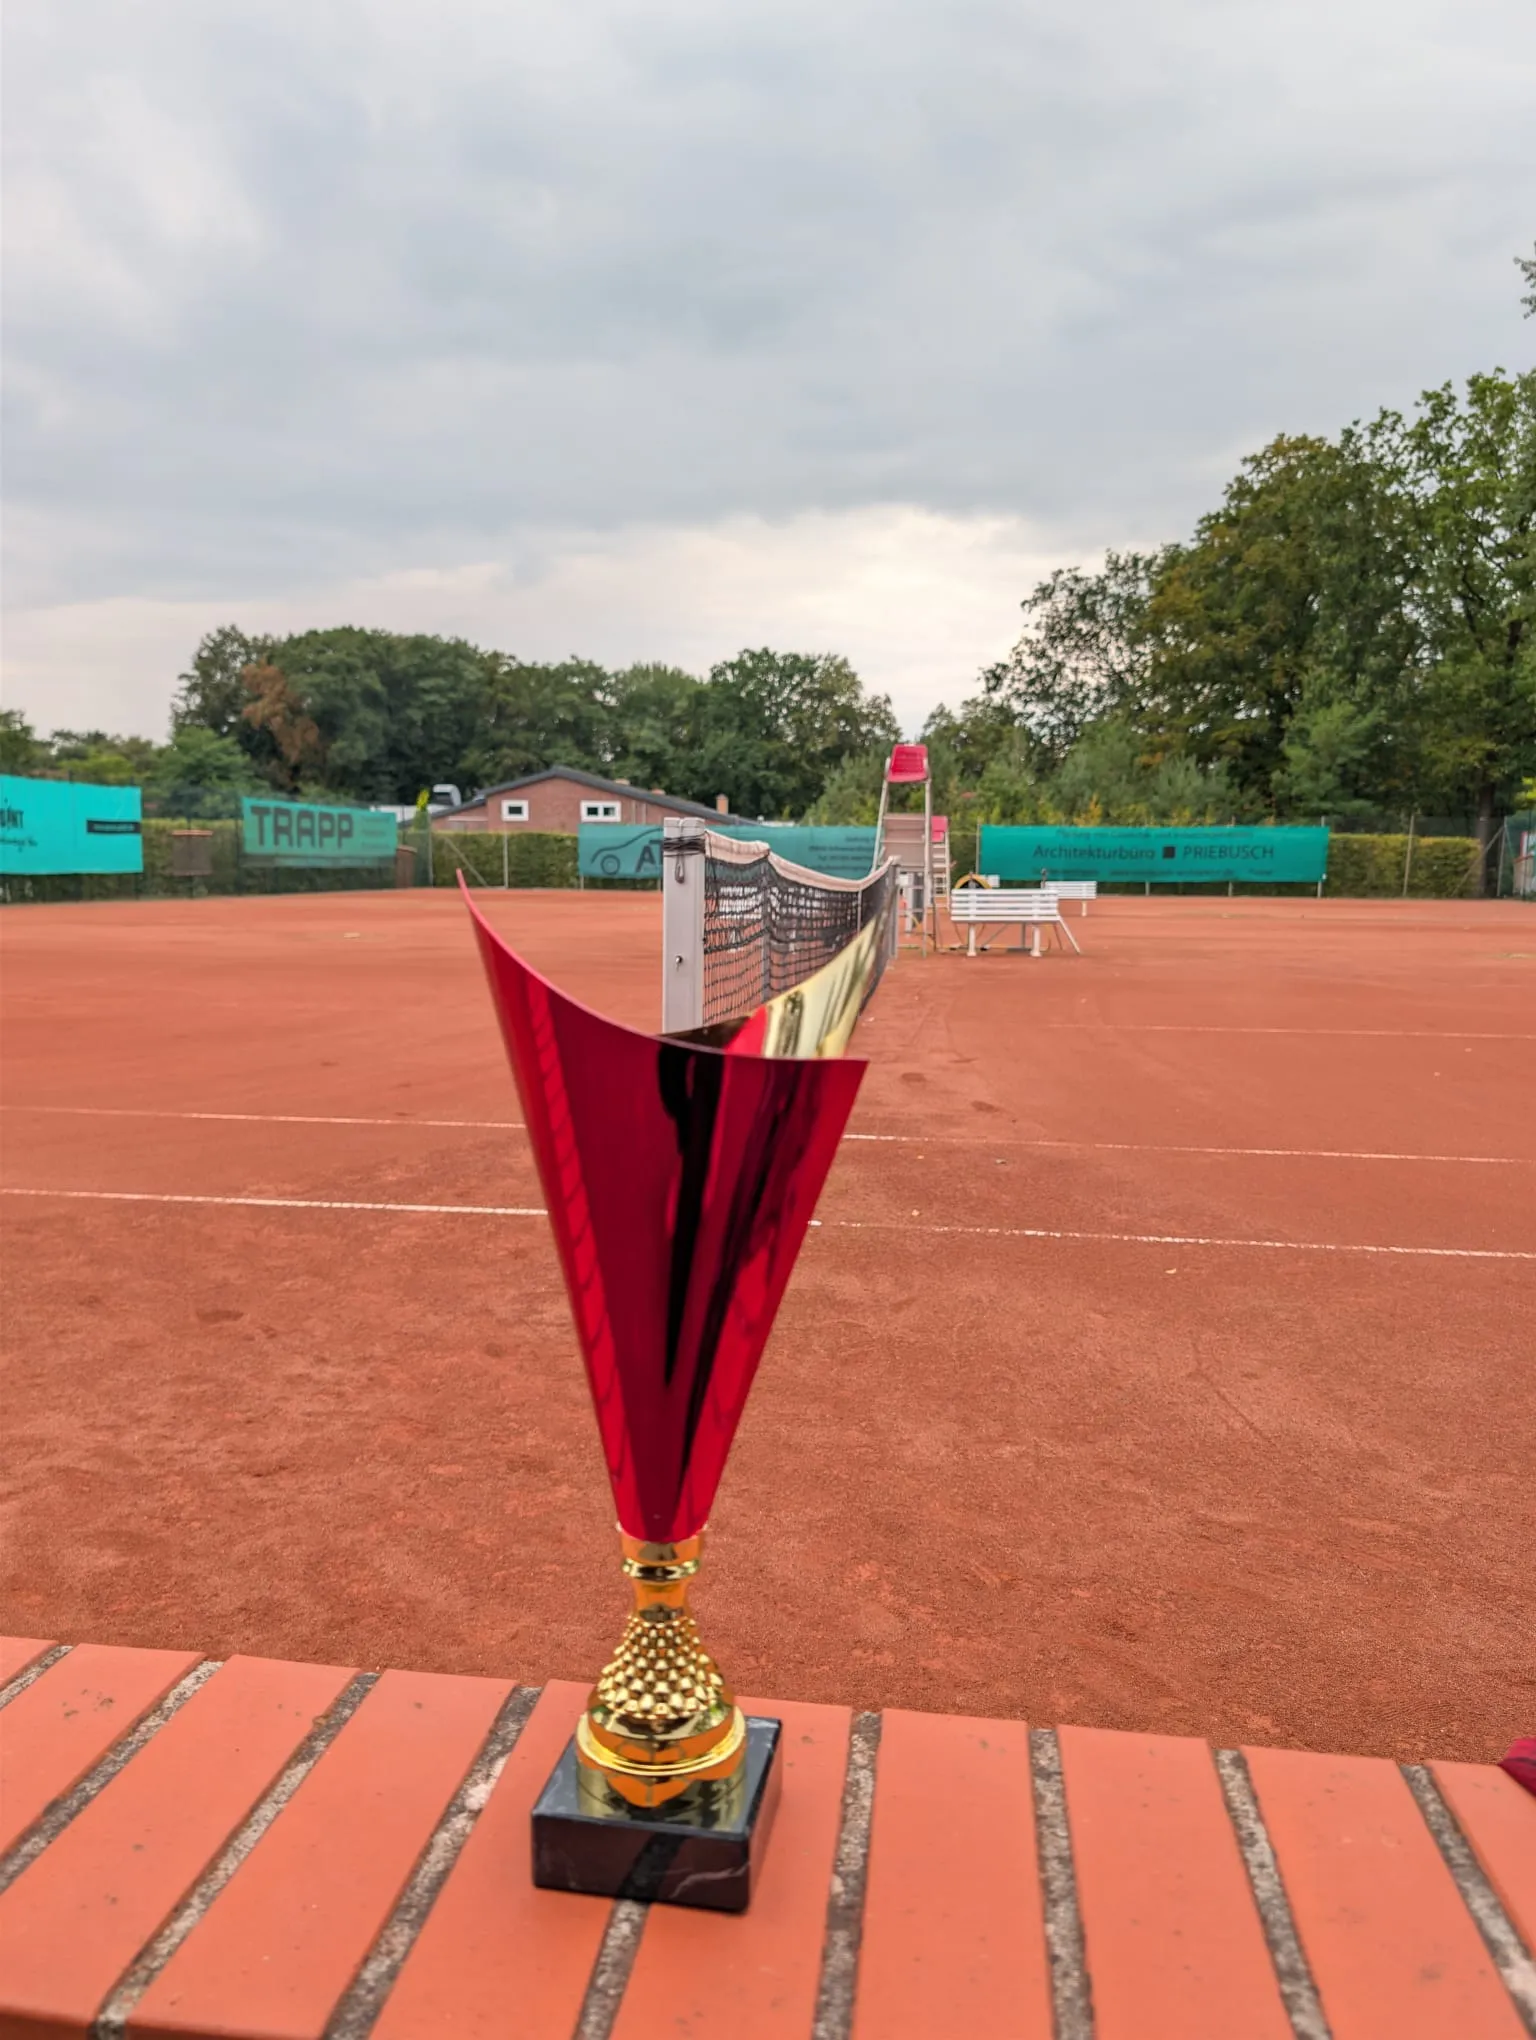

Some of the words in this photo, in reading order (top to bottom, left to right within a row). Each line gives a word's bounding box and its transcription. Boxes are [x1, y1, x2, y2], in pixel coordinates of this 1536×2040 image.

[250, 806, 354, 848] TRAPP
[1032, 845, 1156, 860] Architekturbüro
[1182, 845, 1275, 860] PRIEBUSCH
